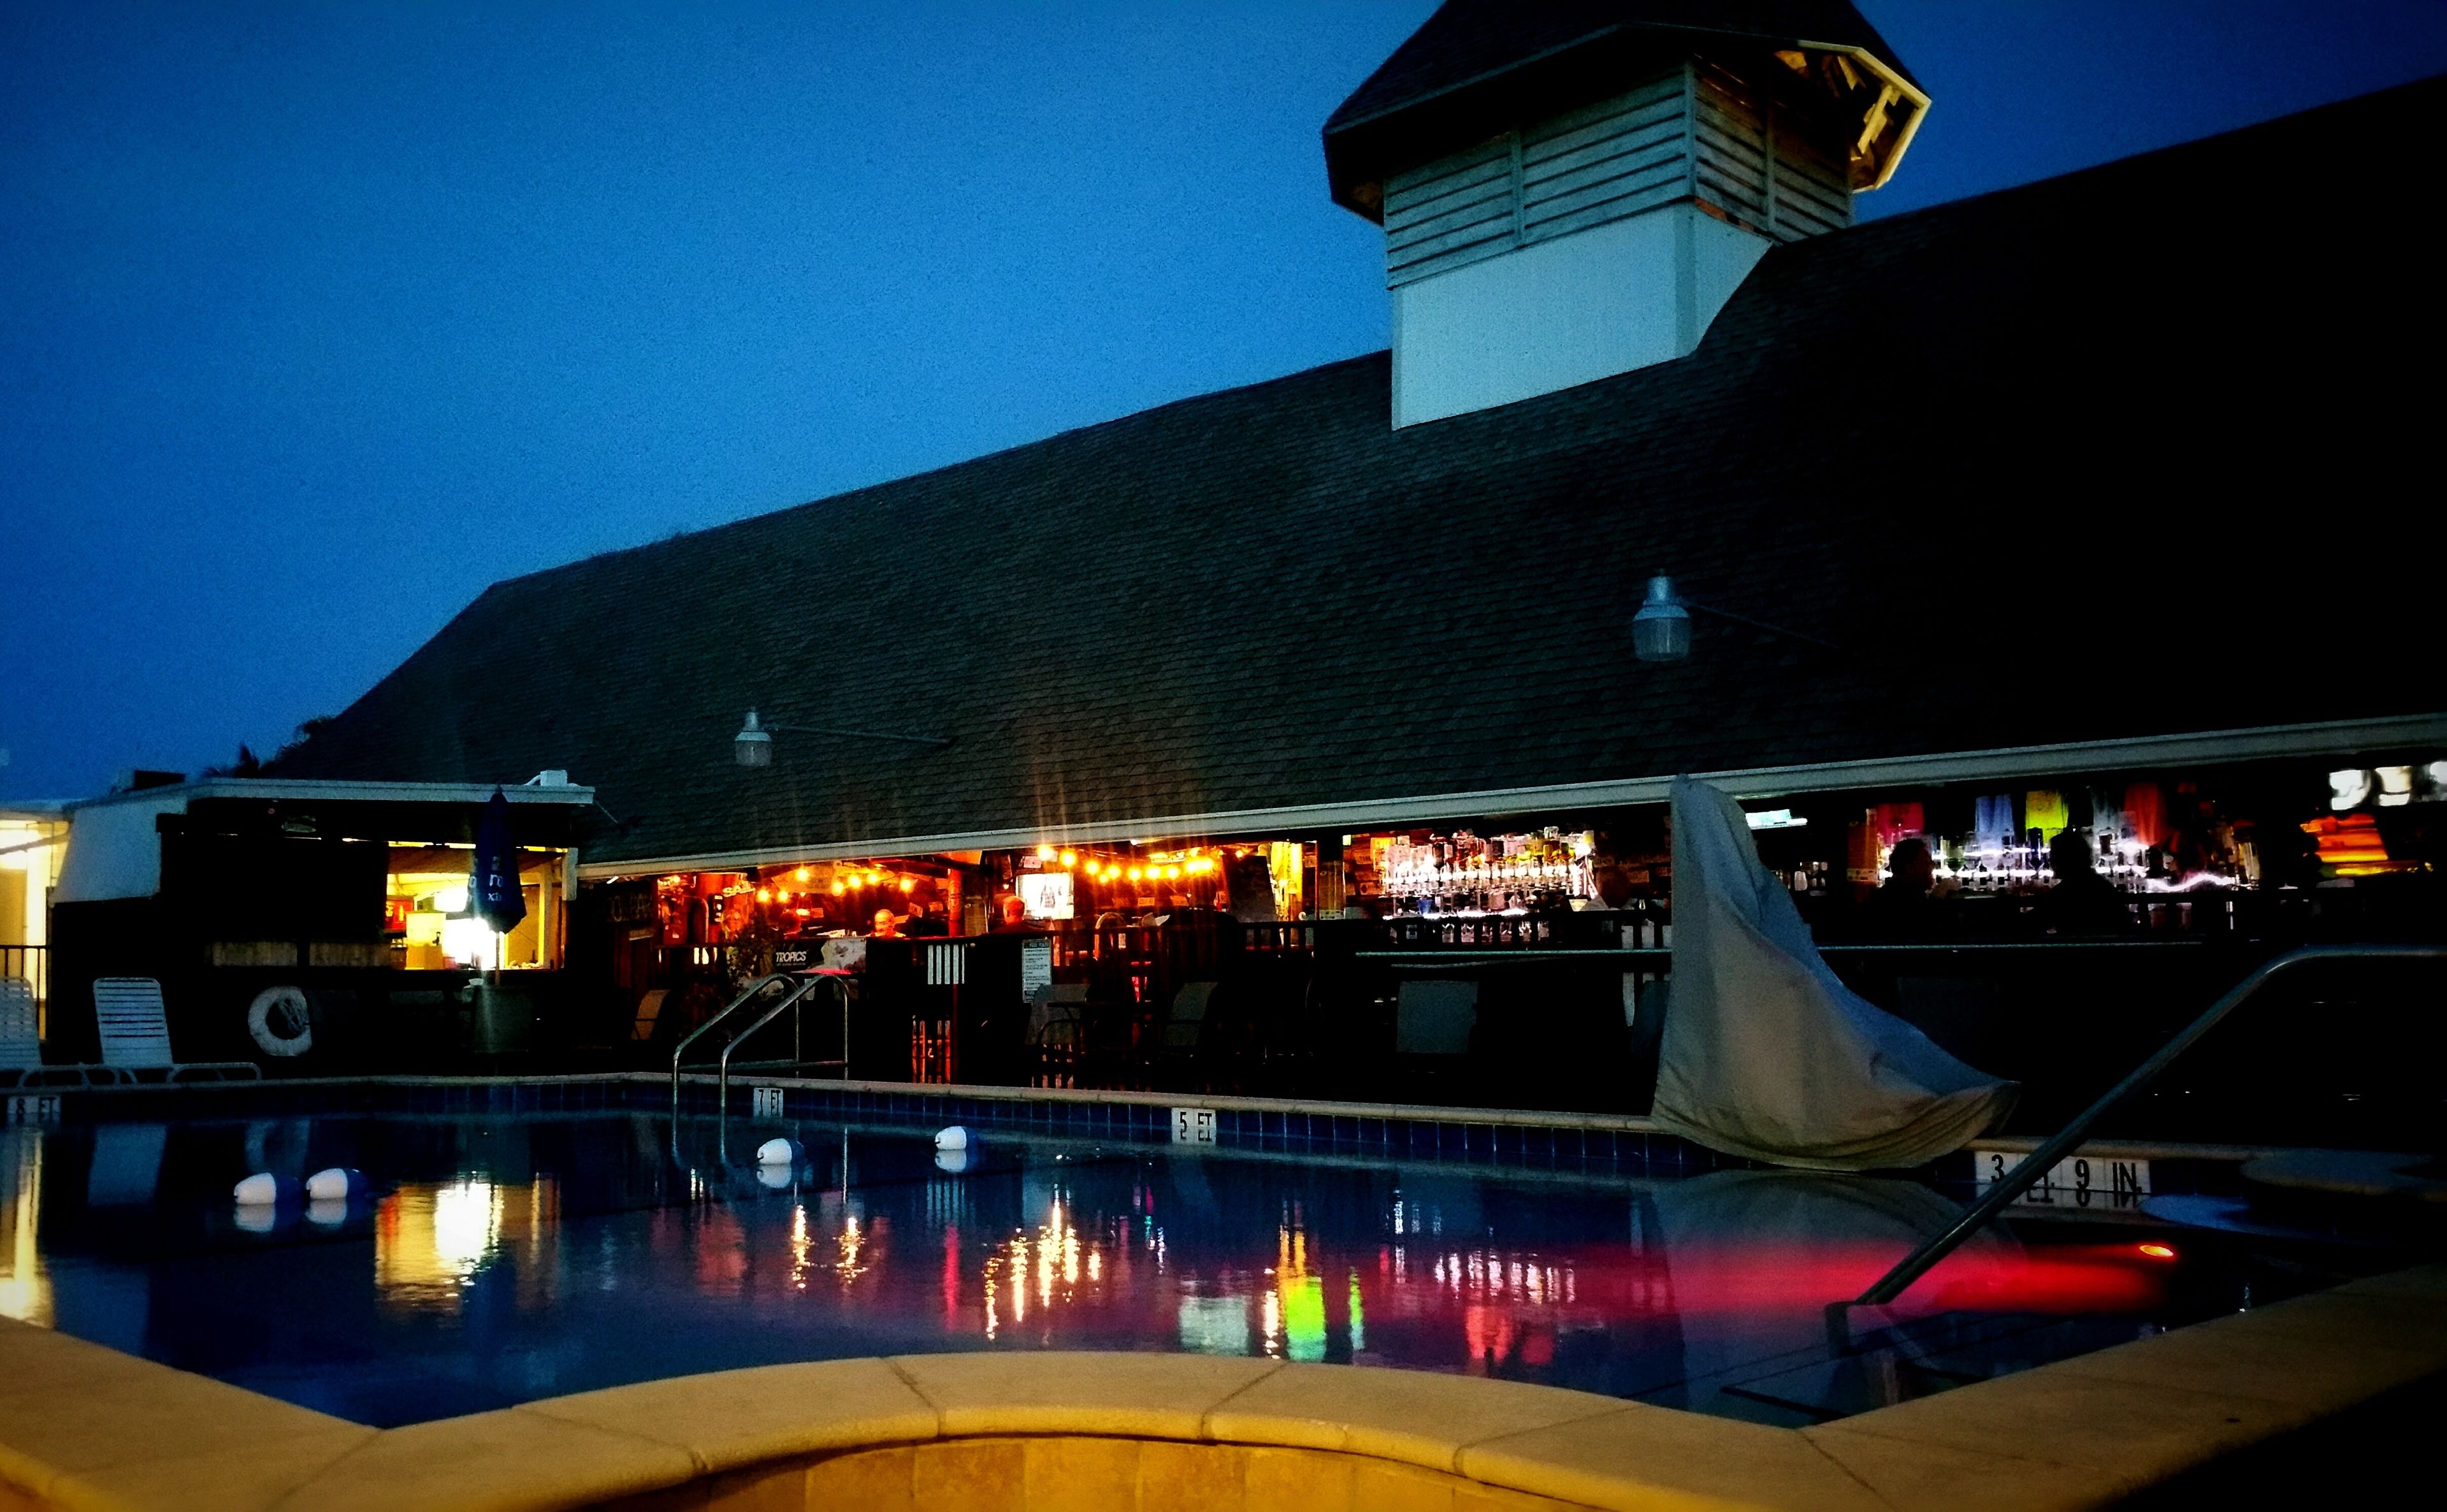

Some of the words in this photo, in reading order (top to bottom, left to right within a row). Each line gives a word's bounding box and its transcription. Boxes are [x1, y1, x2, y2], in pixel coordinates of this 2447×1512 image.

[775, 951, 807, 963] TROPICS
[1991, 1154, 2005, 1183] 3
[2075, 1158, 2090, 1190] 9
